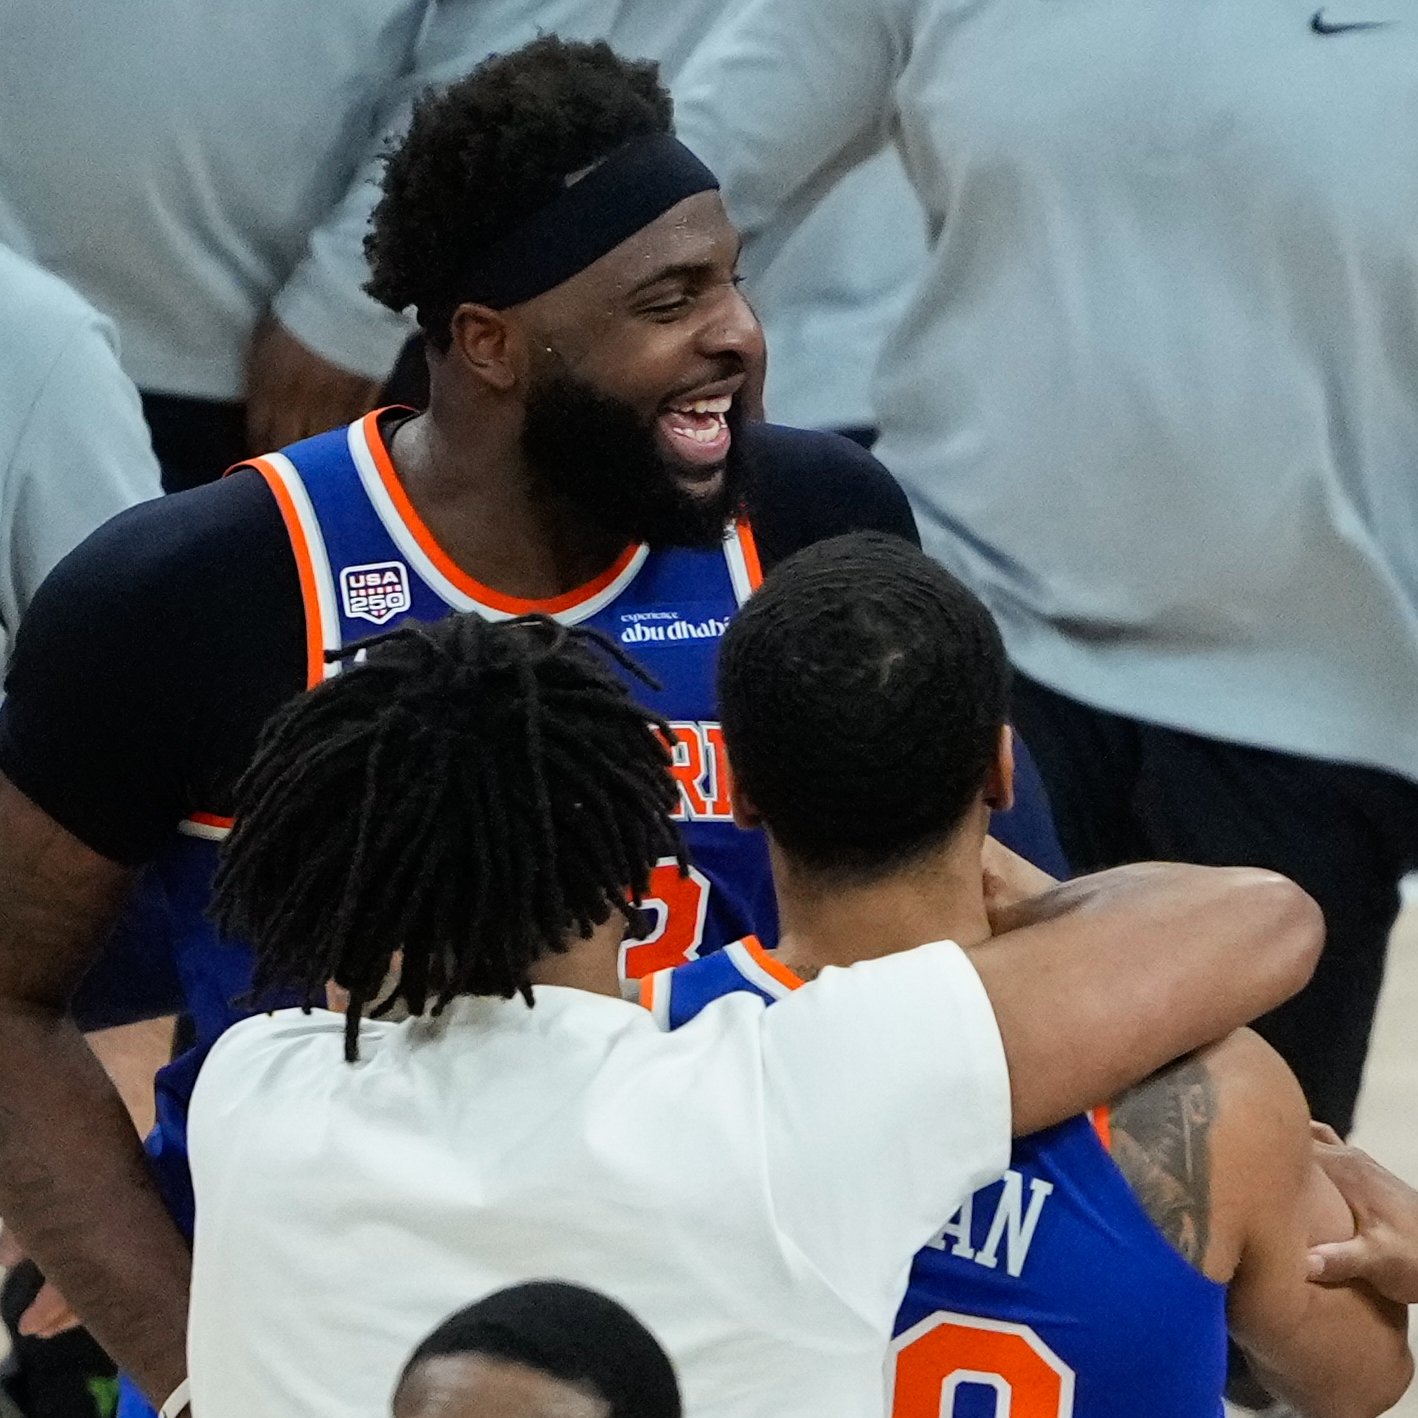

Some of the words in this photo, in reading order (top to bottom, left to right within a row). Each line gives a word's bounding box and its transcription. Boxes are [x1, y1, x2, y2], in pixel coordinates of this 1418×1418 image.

[349, 571, 399, 588] USA
[350, 593, 404, 612] 250
[621, 622, 665, 642] abu
